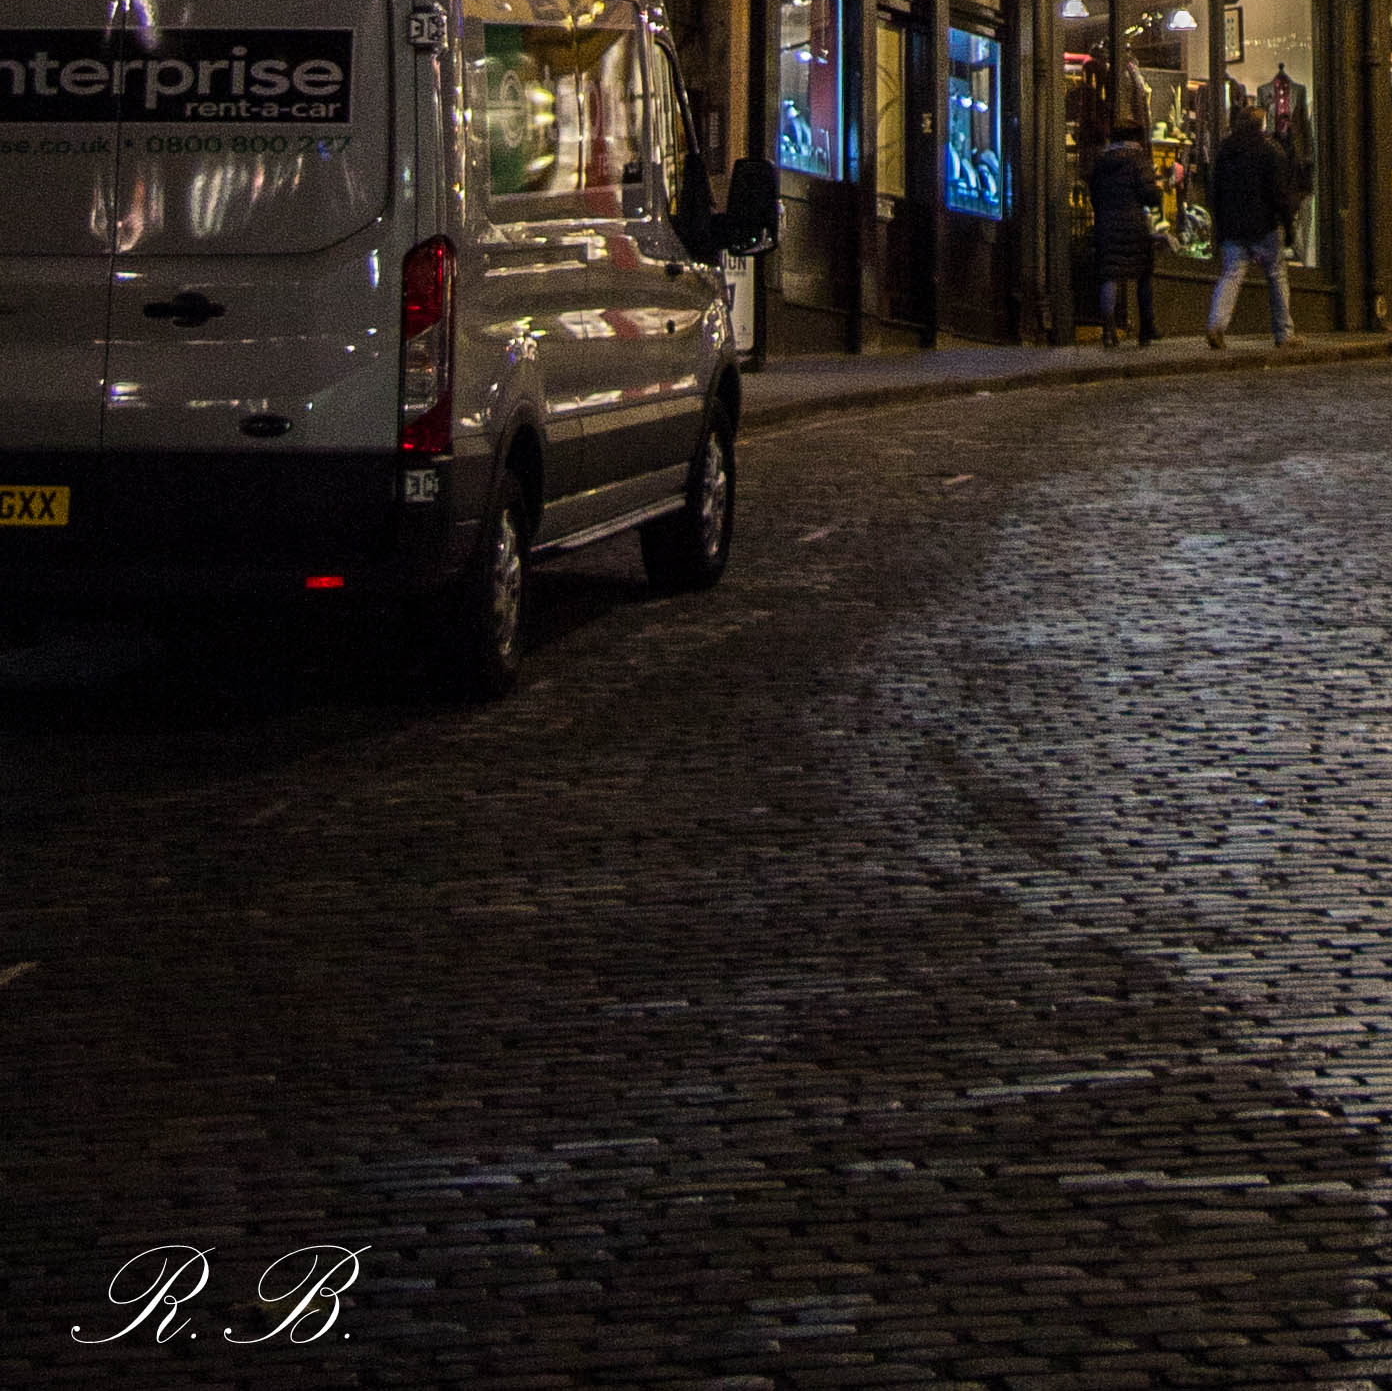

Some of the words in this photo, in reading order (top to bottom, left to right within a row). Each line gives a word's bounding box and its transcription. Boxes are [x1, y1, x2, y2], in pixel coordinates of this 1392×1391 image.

[185, 99, 341, 118] rent-a-car
[147, 136, 218, 154] 0800
[232, 136, 288, 154] 800
[0, 490, 56, 520] GXX
